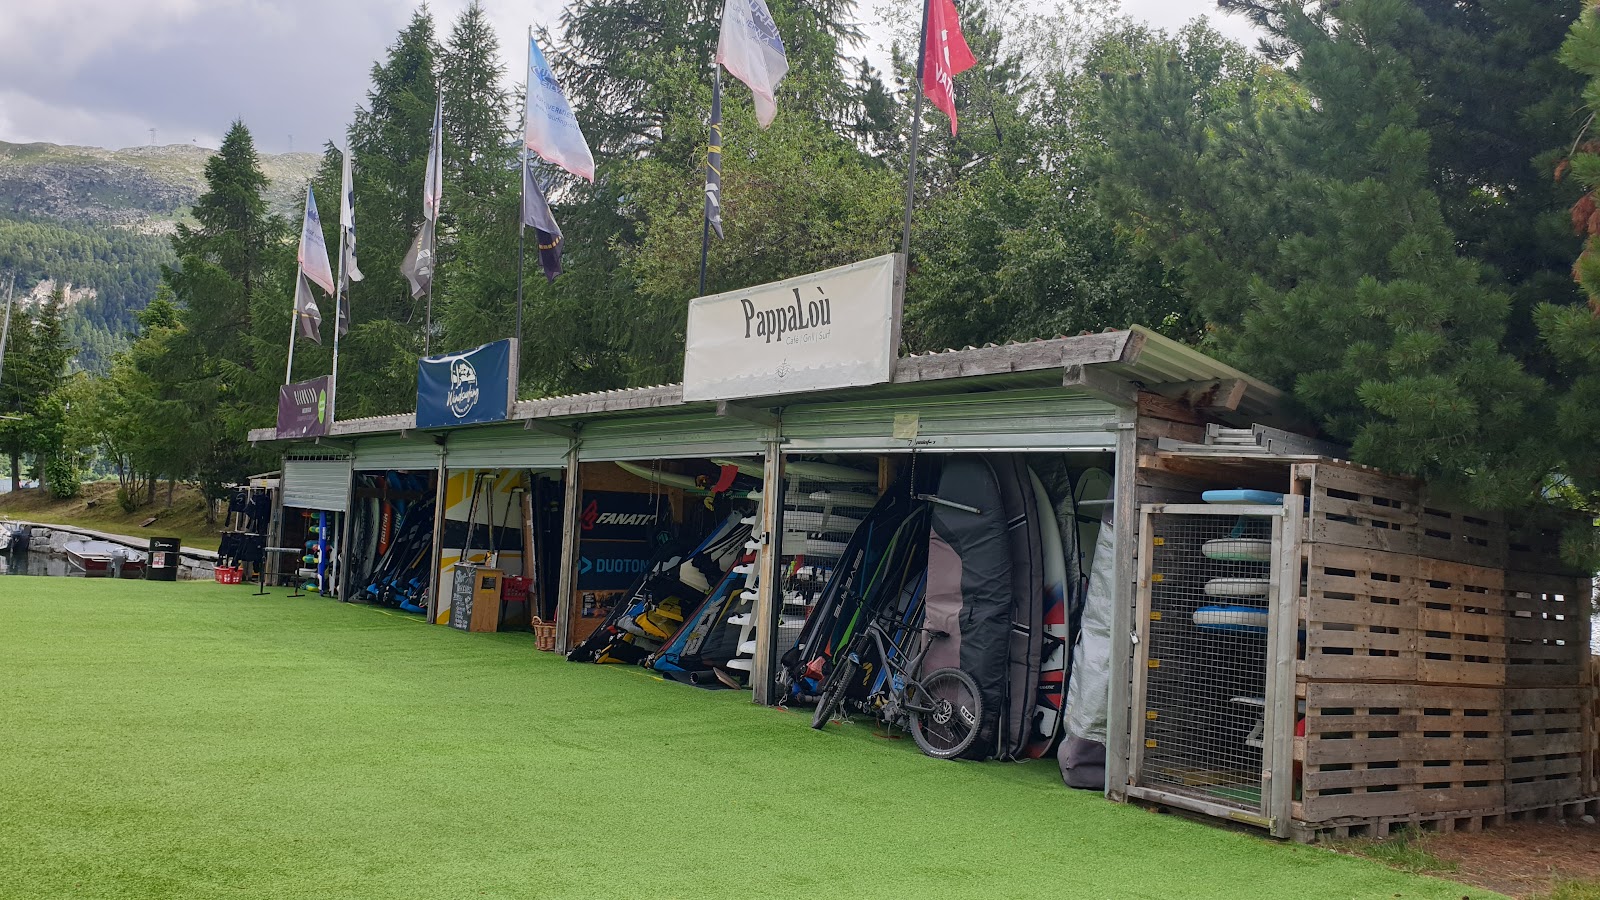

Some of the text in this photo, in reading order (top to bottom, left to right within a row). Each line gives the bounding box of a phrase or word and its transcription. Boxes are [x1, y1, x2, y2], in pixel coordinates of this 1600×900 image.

[741, 286, 831, 343] PappaLoù
[786, 336, 800, 345] Café
[596, 558, 650, 573] DUOTON
